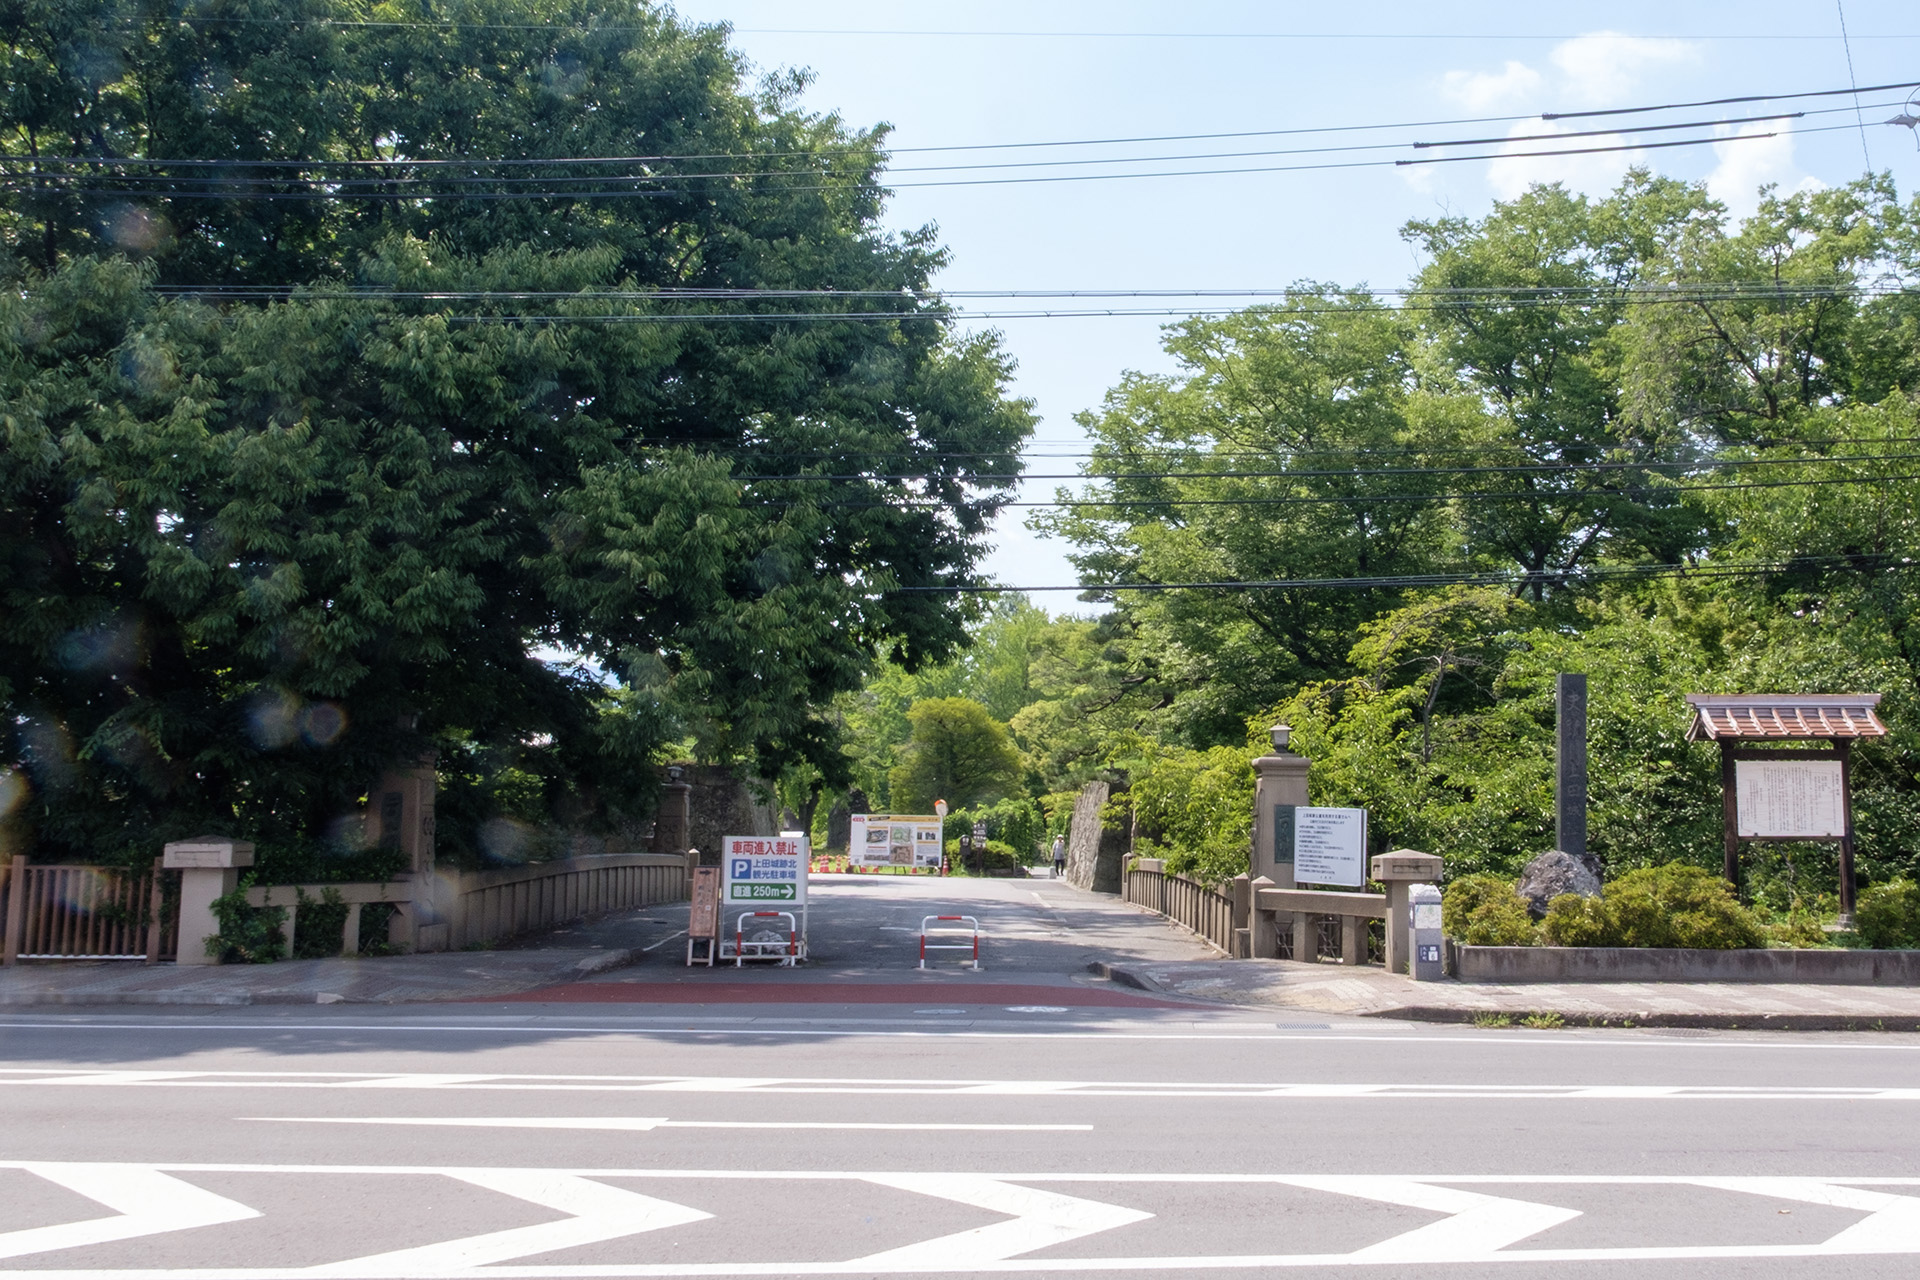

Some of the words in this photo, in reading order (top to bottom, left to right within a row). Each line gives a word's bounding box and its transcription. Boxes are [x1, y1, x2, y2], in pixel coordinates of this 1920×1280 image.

[732, 841, 797, 855] 車両進入禁止
[735, 861, 748, 877] P
[753, 859, 797, 868] 上田城跡北
[753, 870, 796, 879] 観光駐車場
[733, 886, 751, 897] 直進
[753, 886, 780, 897] 250m
